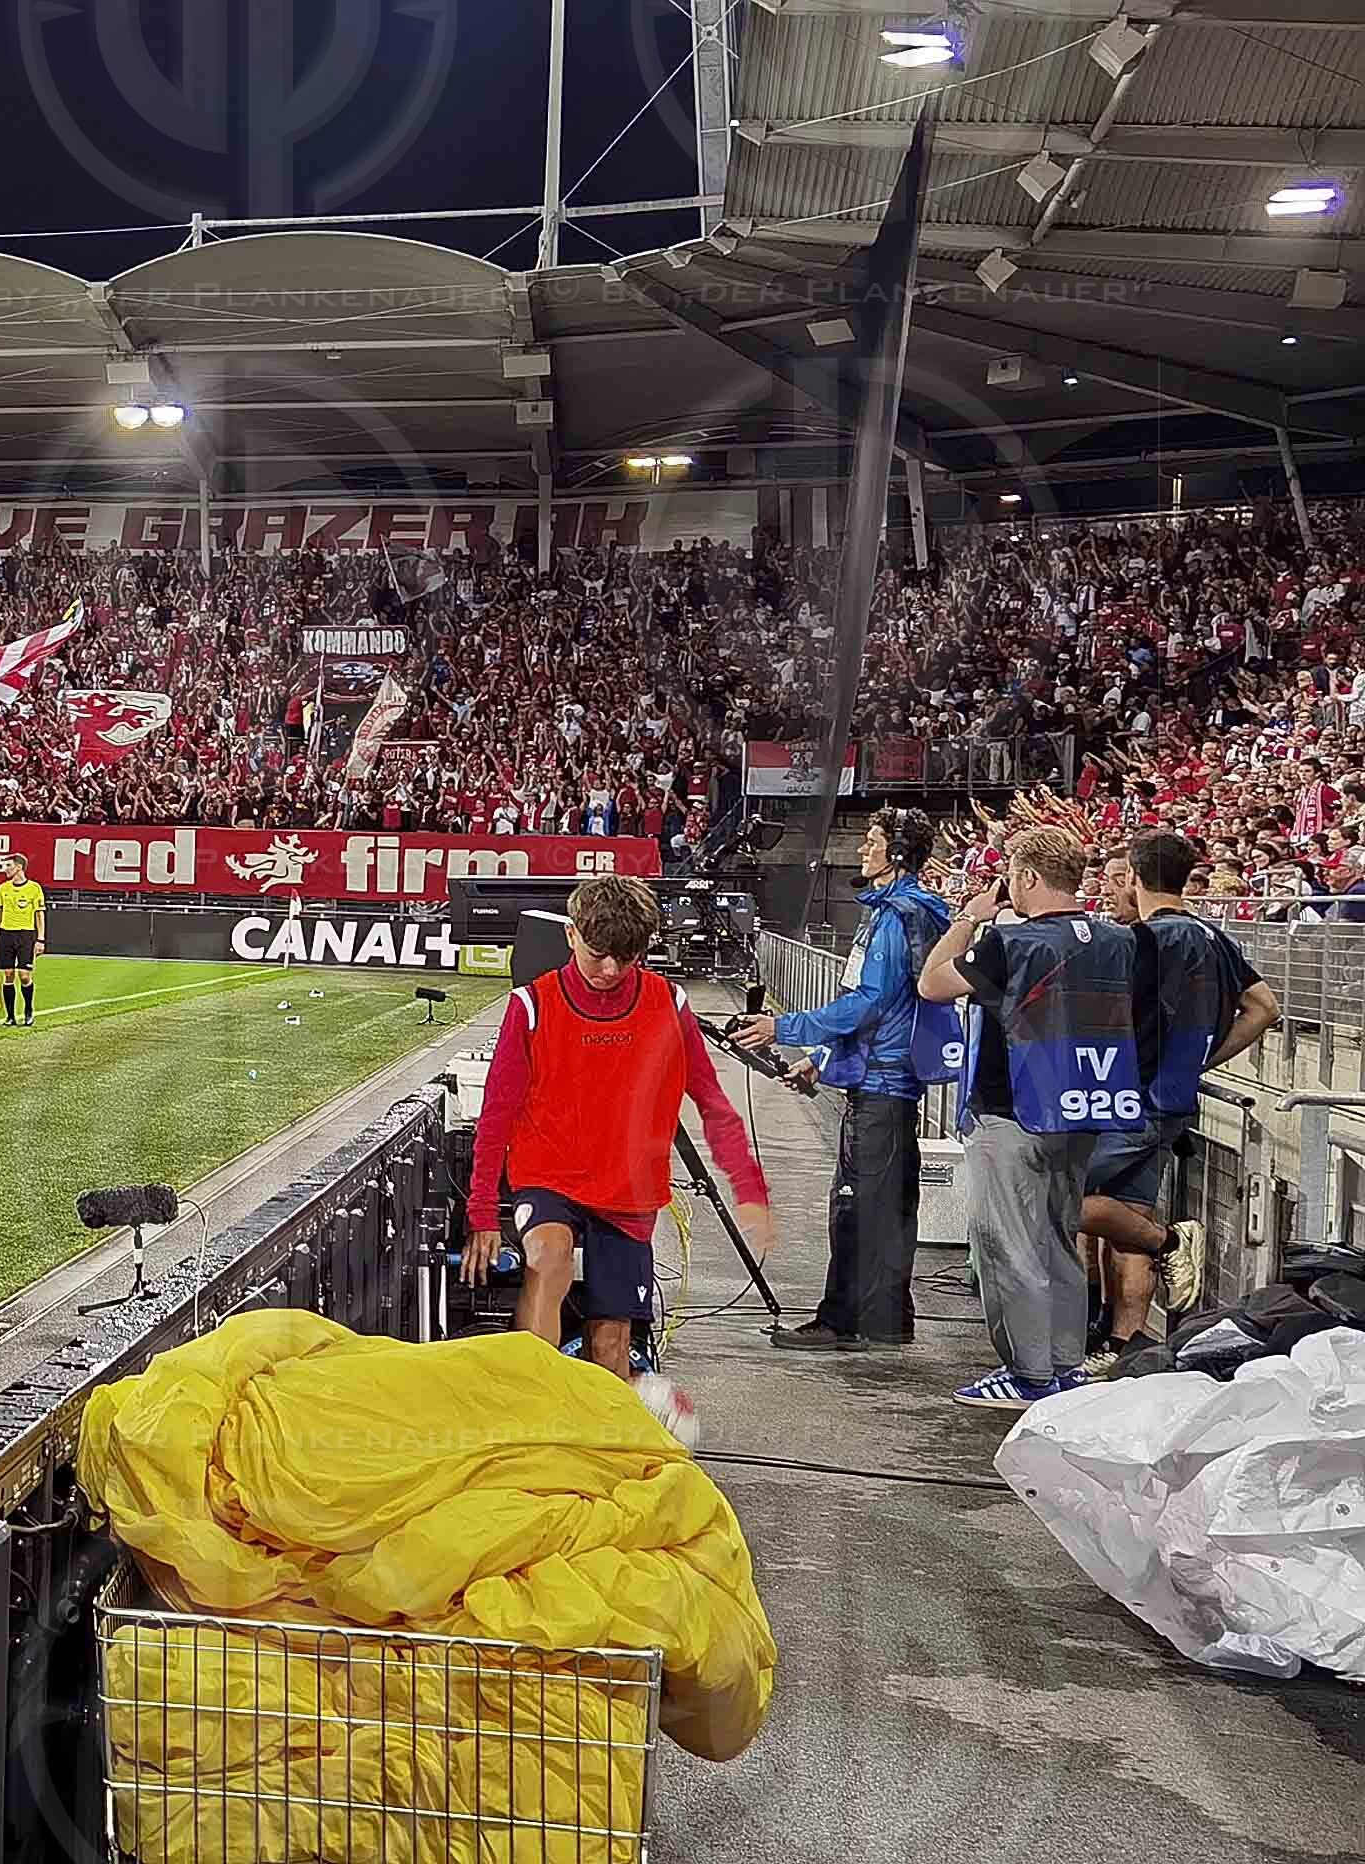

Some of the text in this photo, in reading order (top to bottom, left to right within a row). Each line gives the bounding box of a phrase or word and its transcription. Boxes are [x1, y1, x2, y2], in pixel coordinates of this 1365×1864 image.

[120, 506, 497, 554] GRAZER
[303, 630, 406, 655] KOMMANDO
[53, 829, 530, 894] red firm
[575, 851, 616, 872] GR
[230, 916, 460, 968] CANAL+
[581, 1031, 635, 1047] macron
[1059, 1089, 1142, 1121] 926
